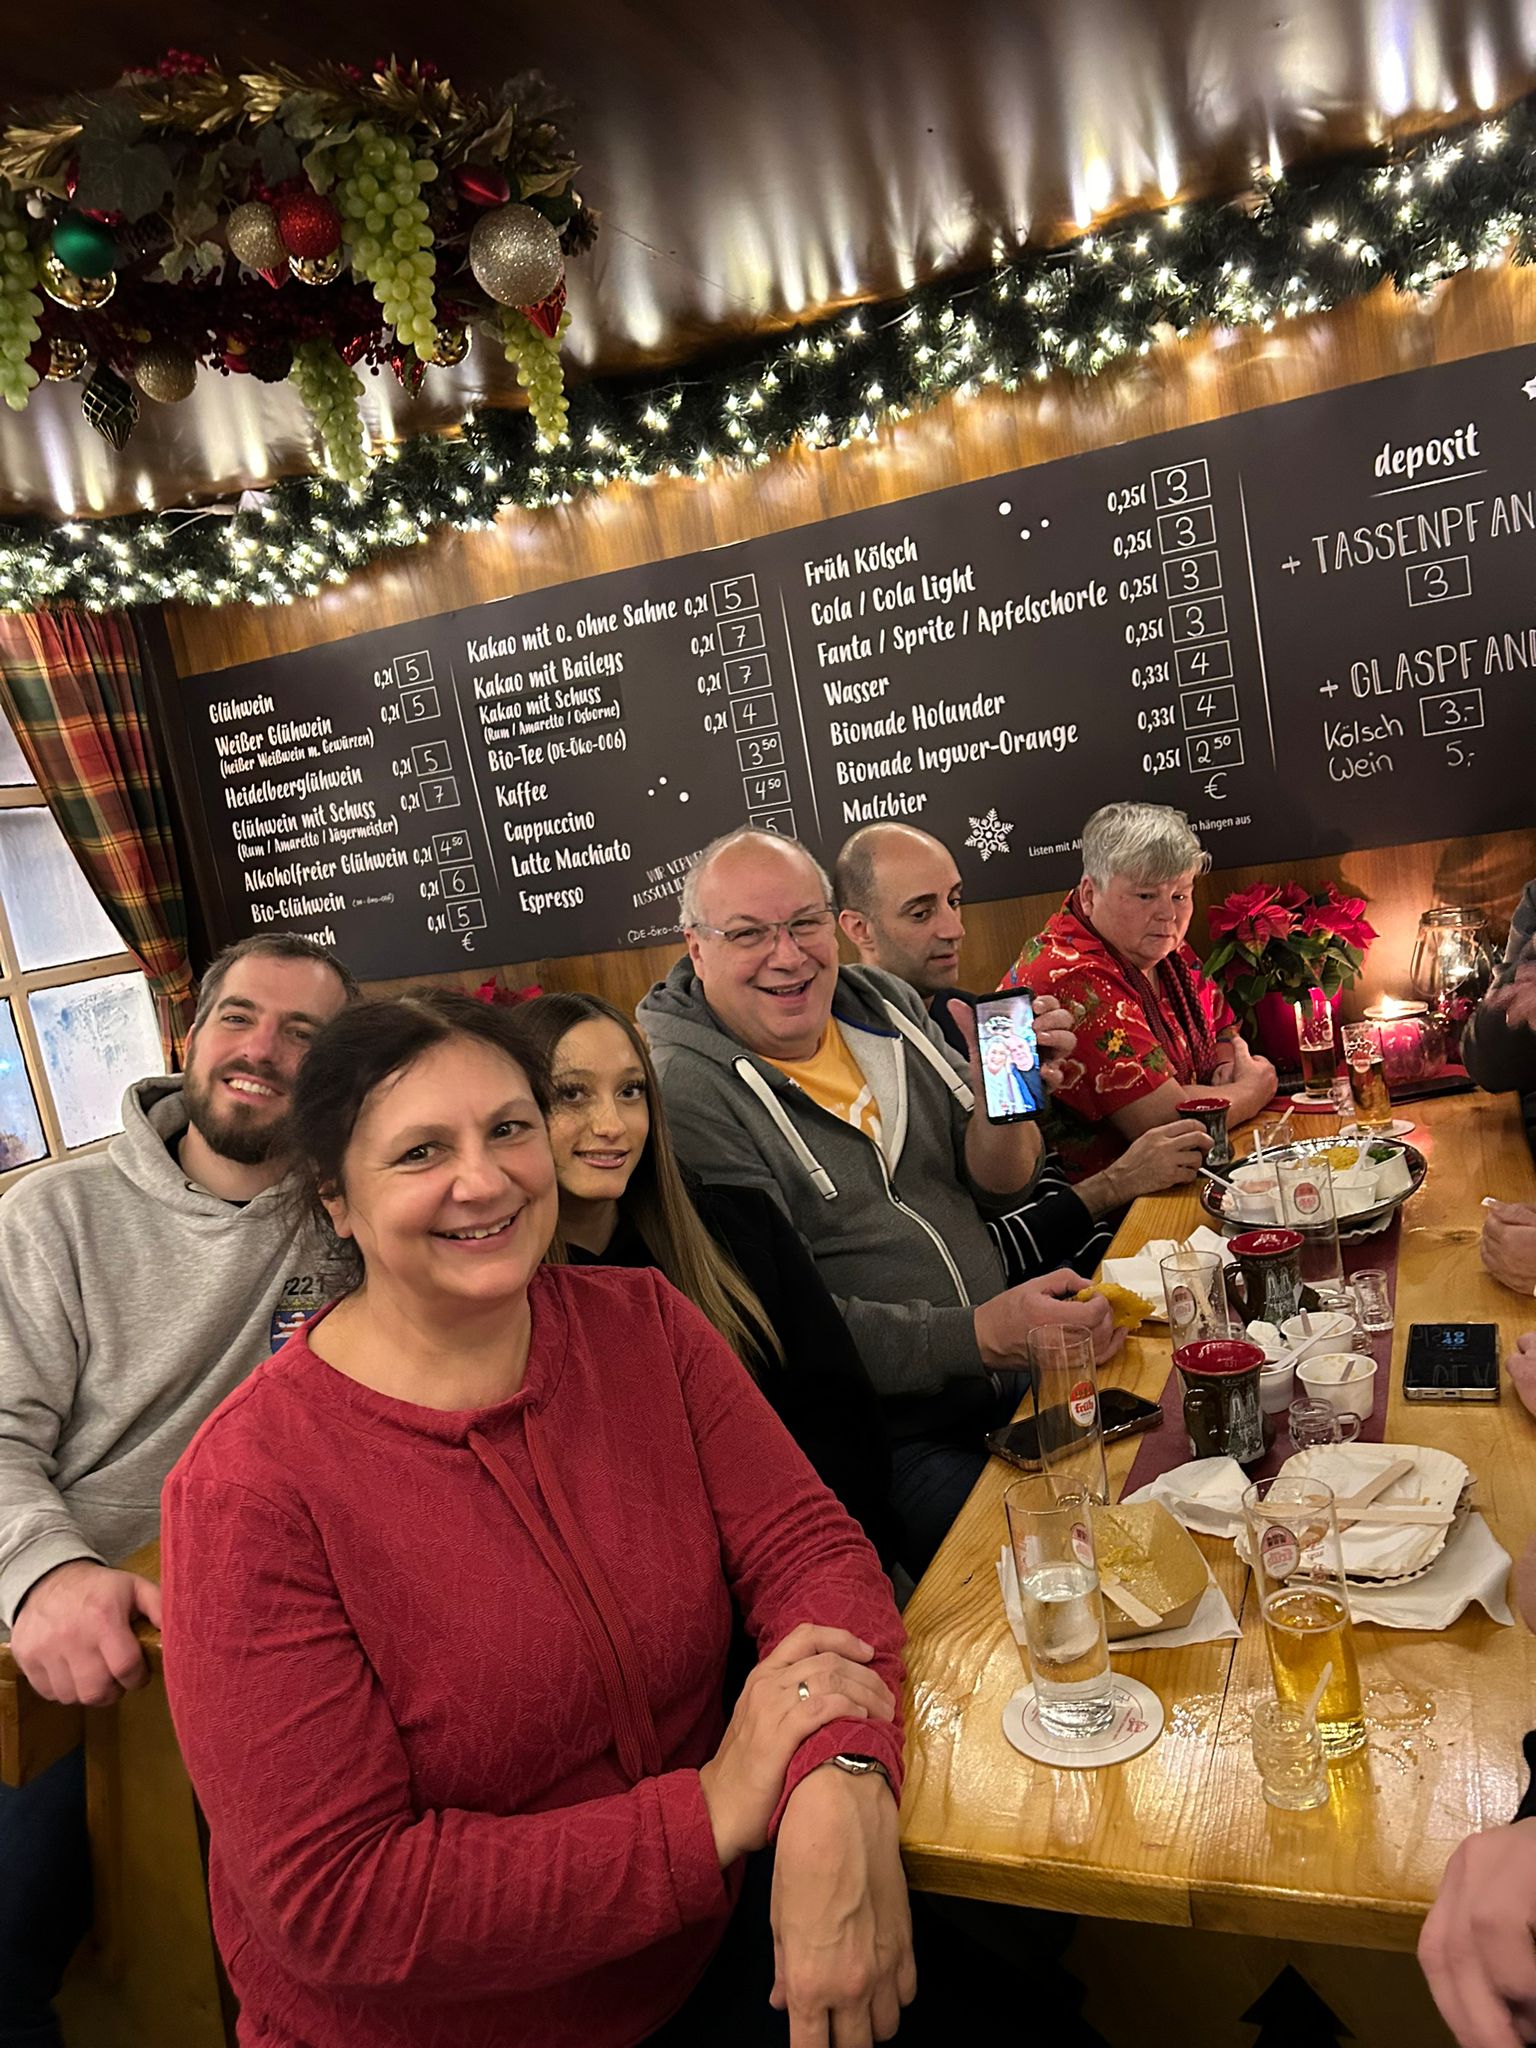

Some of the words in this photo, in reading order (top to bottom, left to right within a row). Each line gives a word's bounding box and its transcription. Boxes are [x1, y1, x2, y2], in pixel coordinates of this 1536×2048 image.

[1374, 423, 1480, 479] deposit
[804, 553, 850, 587] Früh
[854, 536, 918, 574] Kölsch
[1107, 483, 1147, 515] 0,25l
[1165, 467, 1188, 505] 3
[1311, 490, 1536, 574] TASSENPFAN
[811, 596, 853, 626] Cola
[860, 590, 865, 616] /
[872, 581, 916, 612] Cola
[921, 564, 976, 604] Light
[1113, 528, 1153, 560] 0,25l
[1175, 516, 1196, 547] 3
[1423, 565, 1449, 598] 3
[466, 635, 517, 664] Kakao
[521, 622, 552, 651] mit
[555, 624, 573, 643] o.
[576, 612, 619, 639] ohne
[622, 599, 678, 627] Sahne
[684, 593, 709, 619] 0,2l
[723, 581, 742, 610] 5
[817, 634, 873, 668] Fanta
[879, 629, 885, 654] /
[893, 615, 956, 655] Sprite
[962, 609, 969, 636] /
[978, 580, 1108, 636] Apfelschorle
[1119, 573, 1158, 604] 0,25l
[1181, 559, 1200, 591] 3
[473, 672, 523, 700] Kakao
[528, 660, 559, 688] mit
[561, 651, 624, 681] Baileys
[691, 633, 715, 657] 0,2l
[731, 625, 746, 648] 7
[823, 677, 890, 706] Wasser
[1125, 617, 1164, 647] 0,25l
[1185, 605, 1205, 638] 3
[209, 694, 275, 724] Glühwein
[374, 667, 394, 690] 0,2l
[405, 658, 420, 681] 5
[479, 702, 522, 725] Kakao
[526, 691, 552, 716] mit
[554, 686, 602, 709] Schuss
[697, 672, 722, 696] 0,2l
[738, 665, 752, 684] 7
[830, 710, 907, 747] Bionade
[911, 692, 1006, 731] Holunder
[1131, 661, 1170, 690] 0,33l
[1190, 652, 1210, 676] 4
[214, 731, 264, 757] Weißer
[267, 716, 333, 746] Glühwein
[380, 703, 401, 725] 0,2l
[412, 694, 425, 717] 5
[484, 726, 510, 746] (Rum
[512, 722, 516, 736] /
[519, 713, 565, 735] Amaretto
[567, 711, 571, 725] /
[574, 699, 620, 724] Osborne)
[488, 743, 545, 772] Bio-Tee
[547, 728, 627, 765] (DE-Öko-006)
[704, 711, 728, 735] 0,2l
[742, 703, 757, 725] 4
[836, 750, 913, 785] Bionade
[917, 724, 1079, 774] Ingwer-Orange
[1137, 705, 1175, 733] 0,33l
[1196, 693, 1217, 718] 4
[1324, 713, 1404, 751] Kölsch
[220, 756, 255, 779] (heißer
[256, 746, 306, 768] Weißwein
[307, 746, 321, 758] m.
[322, 726, 374, 754] Gewürzen)
[224, 765, 363, 809] Heidelbeerglühwein
[392, 757, 412, 779] 0,2l
[424, 750, 438, 773] 5
[232, 813, 299, 841] Glühwein
[301, 804, 328, 829] mit
[329, 799, 376, 823] Schuss
[400, 792, 421, 813] 0,2l
[433, 785, 444, 804] 7
[495, 780, 549, 808] Kaffee
[842, 792, 927, 824] Malzbier
[1143, 748, 1181, 776] 0,25l
[1204, 772, 1227, 800] €
[237, 842, 265, 863] (Rum
[274, 831, 320, 853] Amaretto
[328, 814, 399, 845] Jägermeister)
[503, 811, 595, 845] Cappuccino
[1028, 845, 1054, 857] Listen
[1055, 842, 1071, 853] mit
[1071, 838, 1083, 850] All
[1198, 818, 1234, 831] hängen
[1235, 815, 1252, 826] aus
[244, 860, 337, 892] Alkoholfreier
[340, 847, 409, 875] Glühwein
[413, 846, 433, 867] 0,2l
[511, 852, 552, 878] Latte
[554, 839, 631, 871] Machiato
[645, 865, 667, 884] WIR
[250, 892, 346, 923] Bio-Glühwein
[420, 879, 440, 901] 0,2l
[452, 870, 466, 893] 6
[518, 886, 584, 915] Espresso
[631, 875, 687, 909] AUSSCHLIE
[427, 913, 447, 934] 0,1l
[457, 905, 470, 928] 5
[461, 931, 475, 952] €
